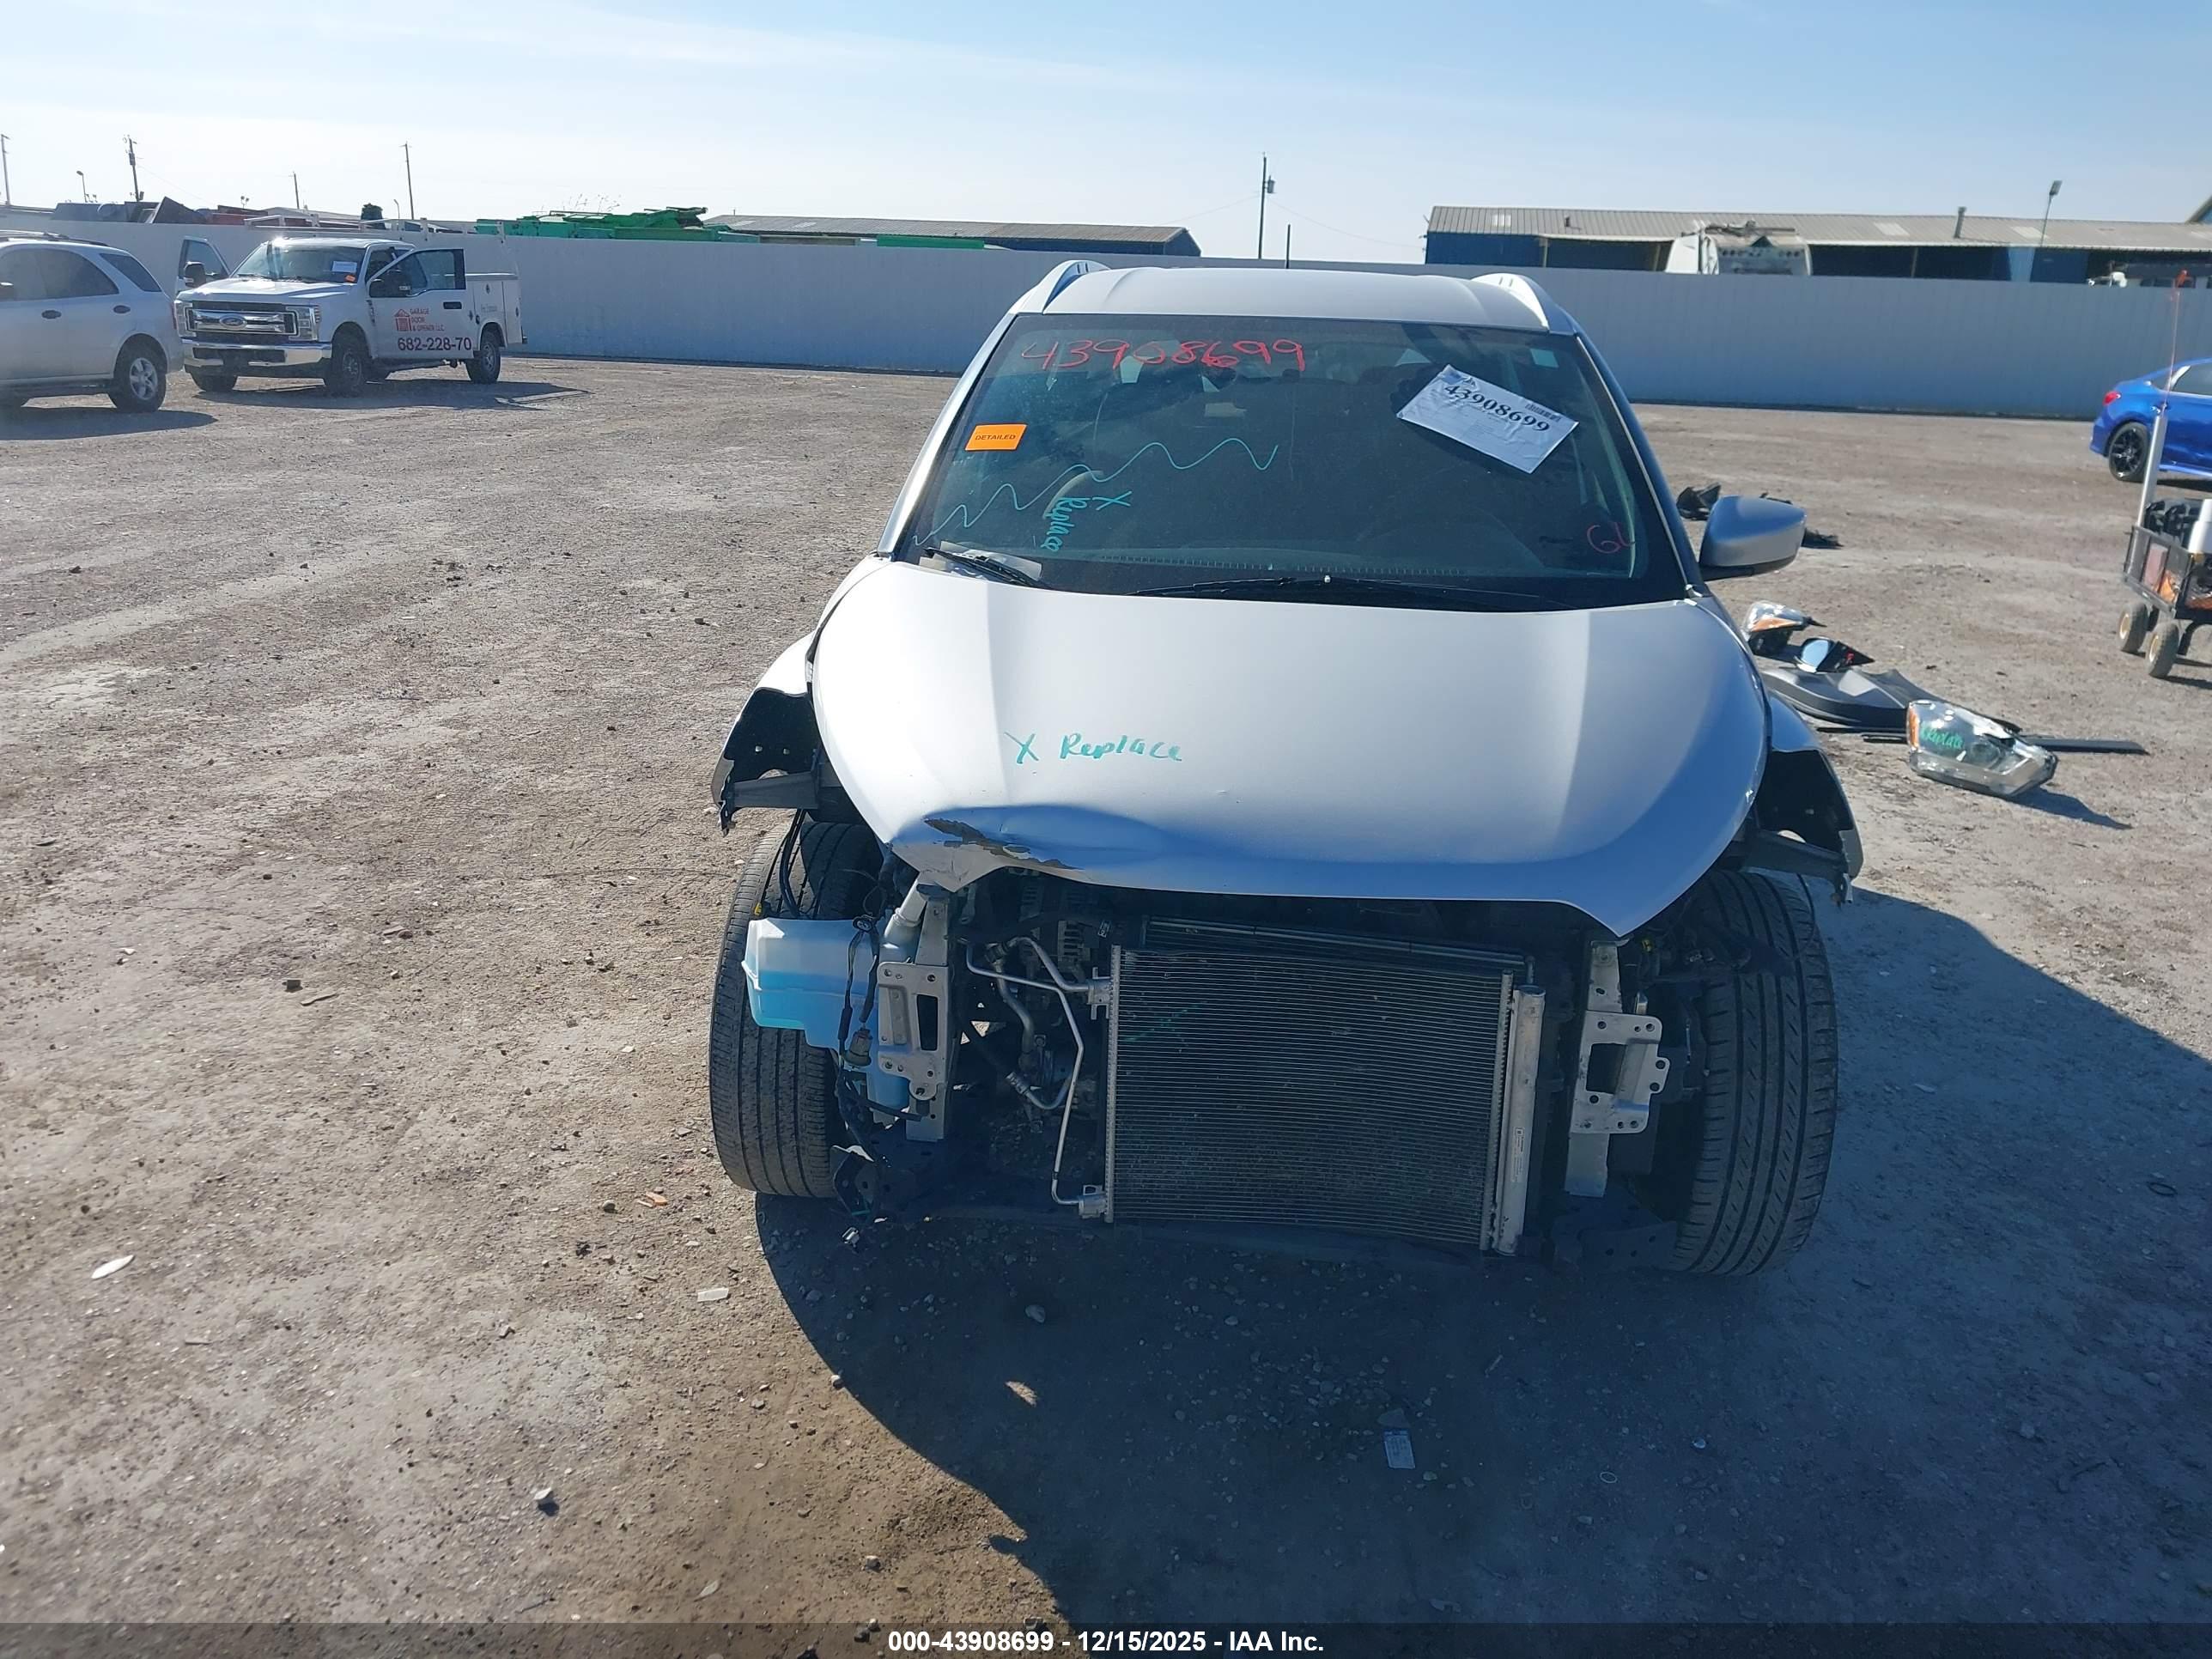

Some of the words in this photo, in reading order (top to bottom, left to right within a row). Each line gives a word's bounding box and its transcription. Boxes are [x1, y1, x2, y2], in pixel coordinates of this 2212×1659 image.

[397, 337, 472, 351] 682-228-70
[1022, 338, 1306, 371] 43908699
[1444, 385, 1551, 432] 43908699
[974, 433, 1017, 441] DETAILED
[1059, 732, 1182, 762] Replace
